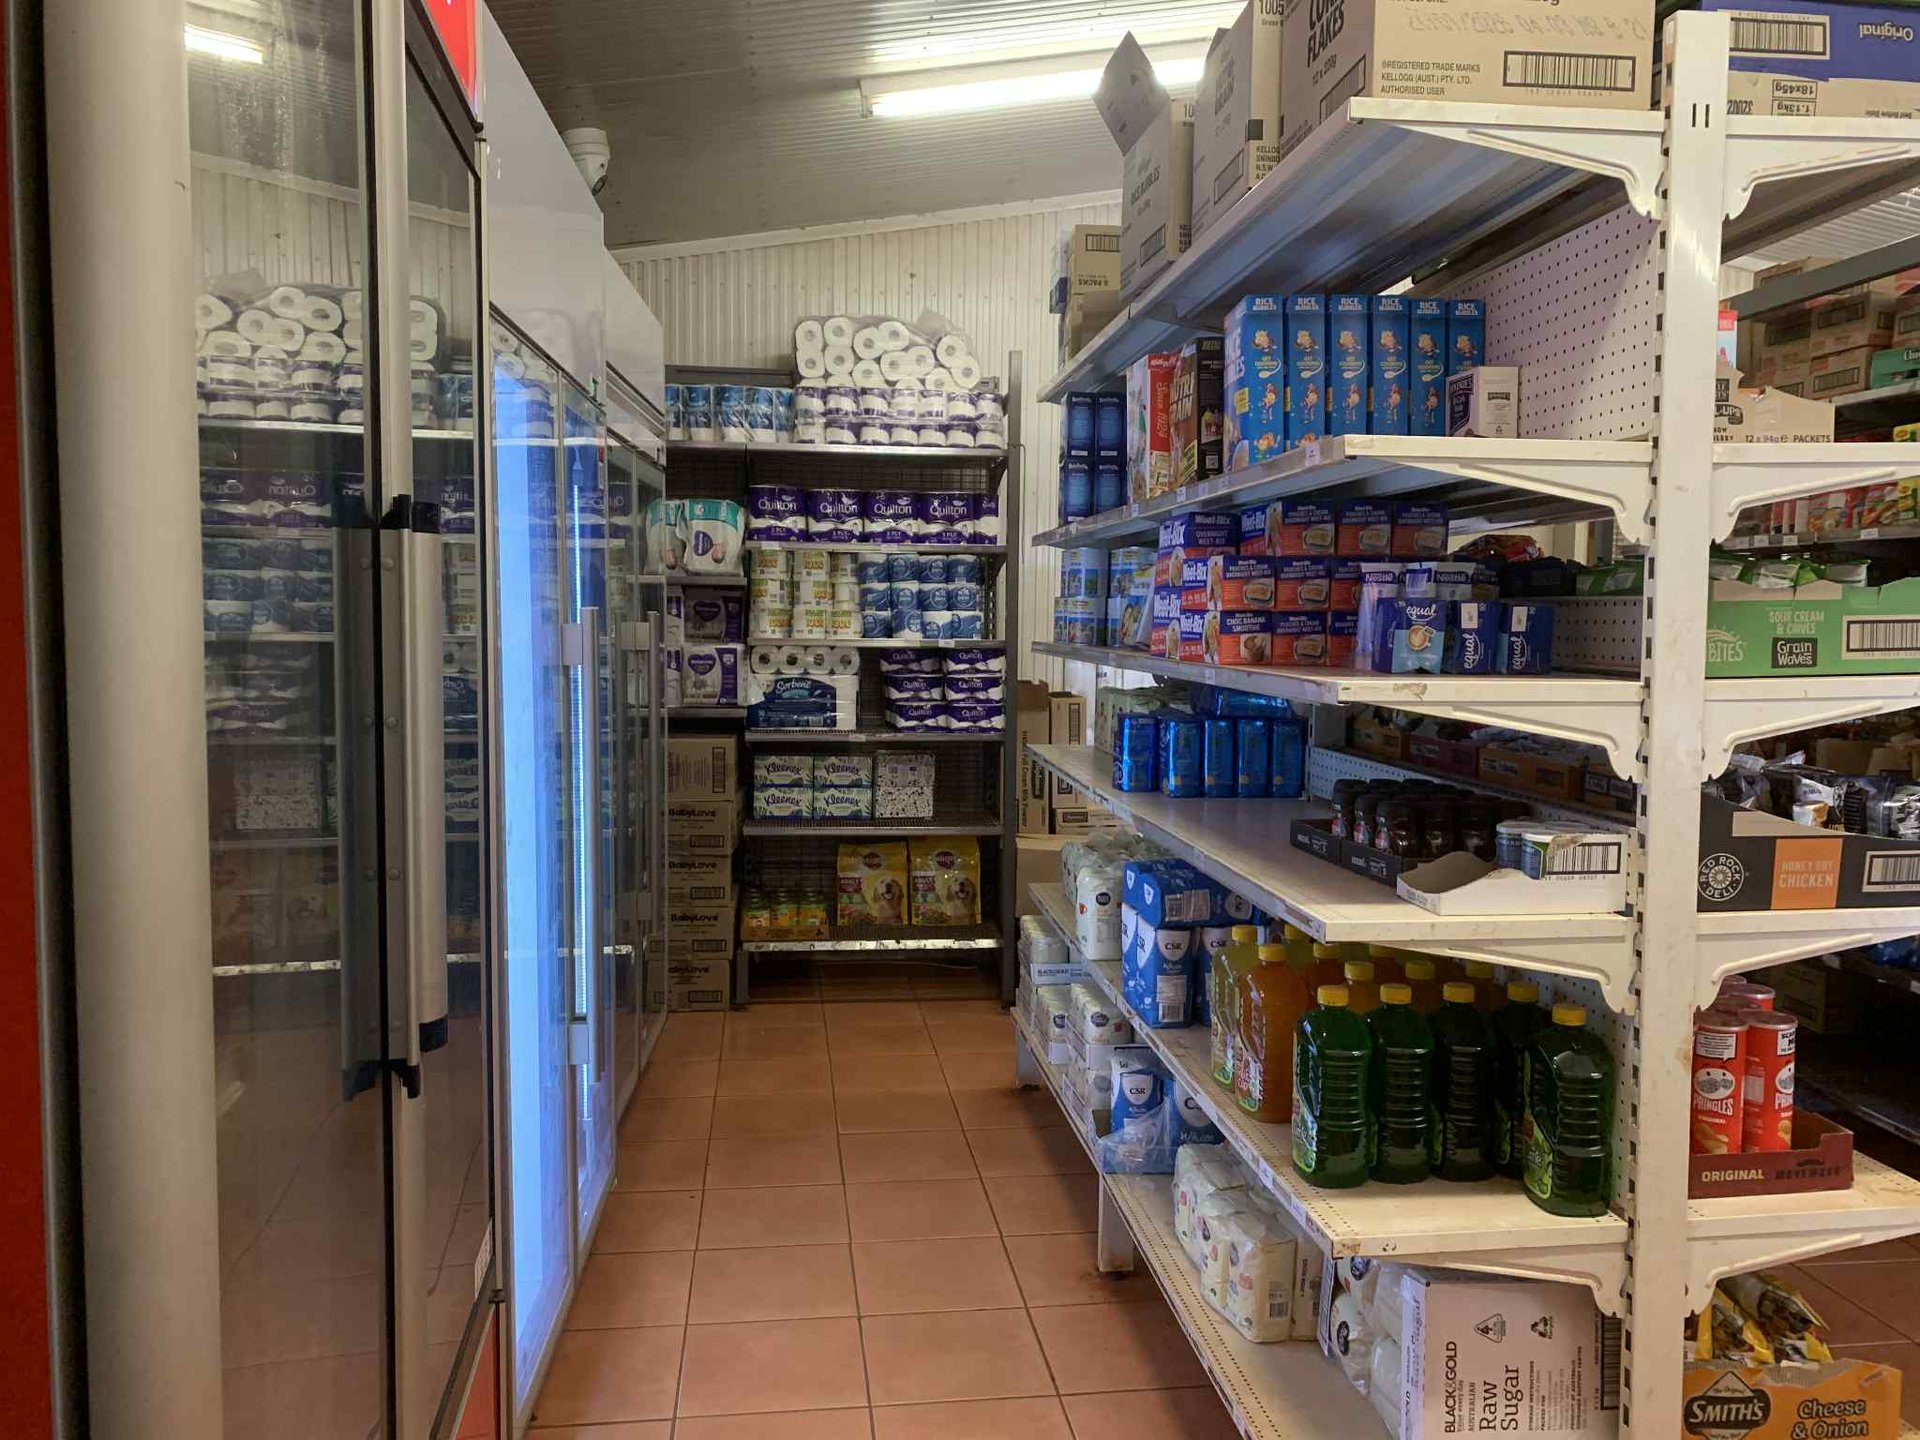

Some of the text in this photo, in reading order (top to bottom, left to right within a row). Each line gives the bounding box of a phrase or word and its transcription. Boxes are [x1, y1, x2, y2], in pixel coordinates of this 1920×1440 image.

[1307, 3, 1344, 68] FLAKES
[1859, 23, 1914, 42] Original
[1432, 62, 1454, 72] TRADE
[1455, 63, 1481, 73] MARKS
[1381, 72, 1413, 82] KELLOGG
[1381, 85, 1445, 95] AUTHORISED USER
[1775, 84, 1814, 95] 18x45g
[1777, 102, 1810, 114] 1.13kg
[1157, 412, 1168, 438] 1924
[1745, 435, 1754, 443] 12
[1793, 435, 1831, 443] PACKETS
[759, 499, 797, 512] Quilton
[820, 502, 858, 515] Quilton
[874, 503, 912, 515] Quilton
[930, 504, 968, 517] Quilton
[1159, 522, 1185, 549] Weet-Bix
[1183, 562, 1208, 582] Weet-Bix
[1365, 573, 1393, 582] Nestlé
[1154, 594, 1181, 618] Weet-Bix
[1406, 604, 1436, 619] equal
[1226, 618, 1242, 627] CHOC
[1769, 611, 1825, 623] SOUR CREAM
[1776, 623, 1816, 634] & CHIVES
[1462, 633, 1478, 669] equal
[1510, 634, 1525, 670] equal
[1777, 640, 1813, 654] Grain
[1777, 652, 1813, 666] Waves
[765, 763, 802, 776] Kleenex
[824, 763, 862, 776] Kleenex
[764, 794, 801, 807] Kleenex
[824, 794, 861, 807] Kleenex
[1700, 856, 1742, 882] RED ROCK
[1779, 873, 1834, 888] CHICKEN
[1705, 886, 1735, 899] DELI
[1694, 1093, 1734, 1116] PRINGLES
[1702, 1169, 1764, 1182] ORIGINAL
[1444, 1341, 1457, 1433] BLACK&GOLD
[1500, 1365, 1524, 1431] Sugar
[1468, 1381, 1476, 1432] AUSTRALIAN
[1479, 1380, 1497, 1431] Raw
[1689, 1399, 1765, 1423] SMITH'S
[1799, 1399, 1866, 1418] Cheese
[1792, 1420, 1868, 1439] & Onion
